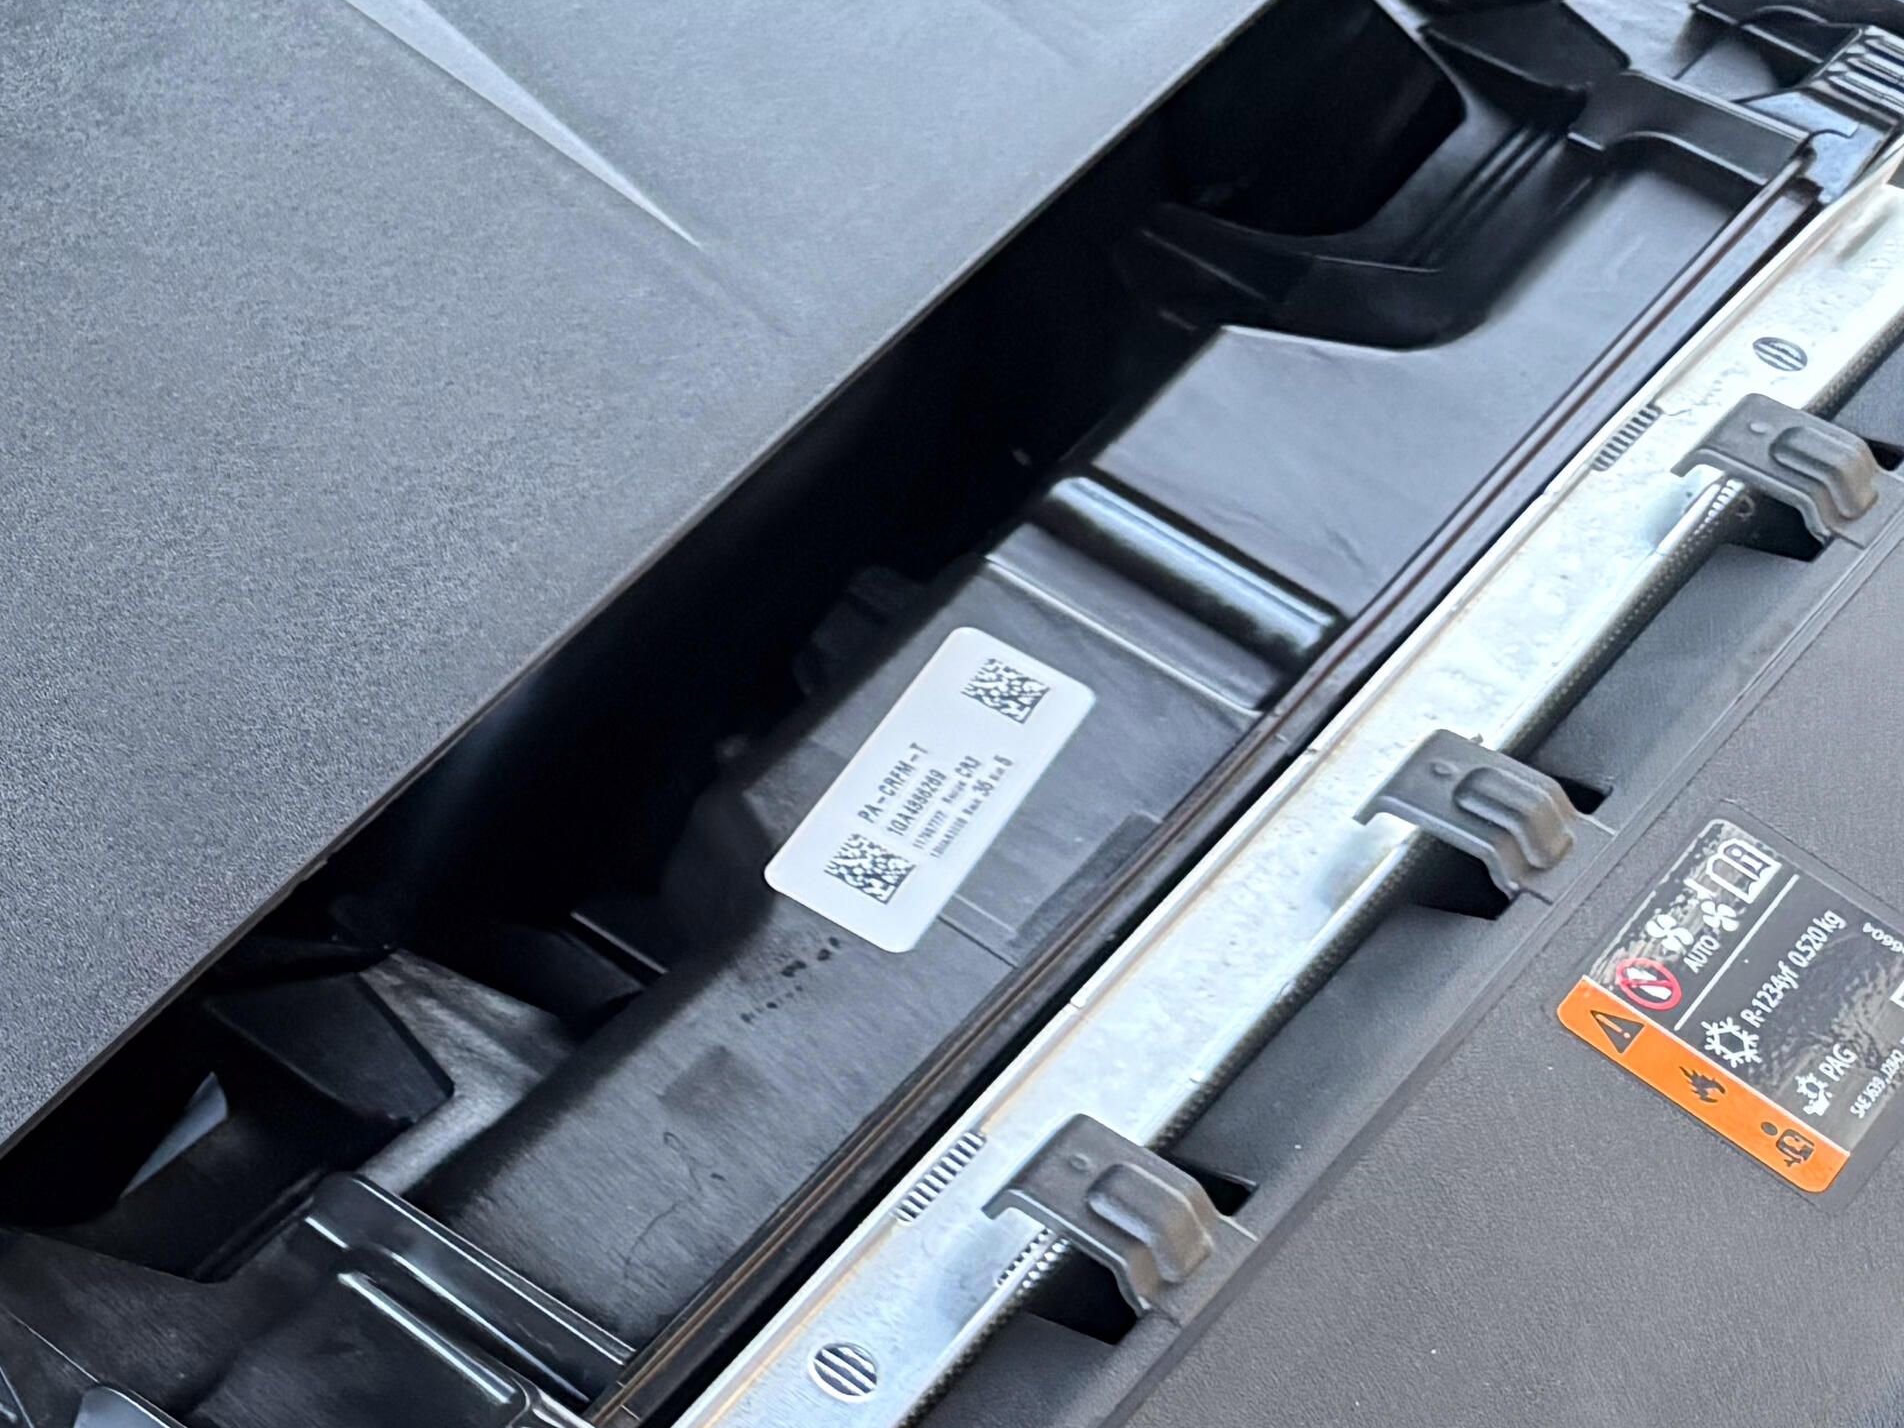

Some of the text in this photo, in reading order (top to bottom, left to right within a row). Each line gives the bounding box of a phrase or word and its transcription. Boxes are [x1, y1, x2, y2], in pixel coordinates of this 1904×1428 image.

[1683, 936, 1721, 973] AUTO
[1740, 909, 1847, 1029] R-1234yf 0.520 kg
[1819, 1043, 1858, 1082] PAG
